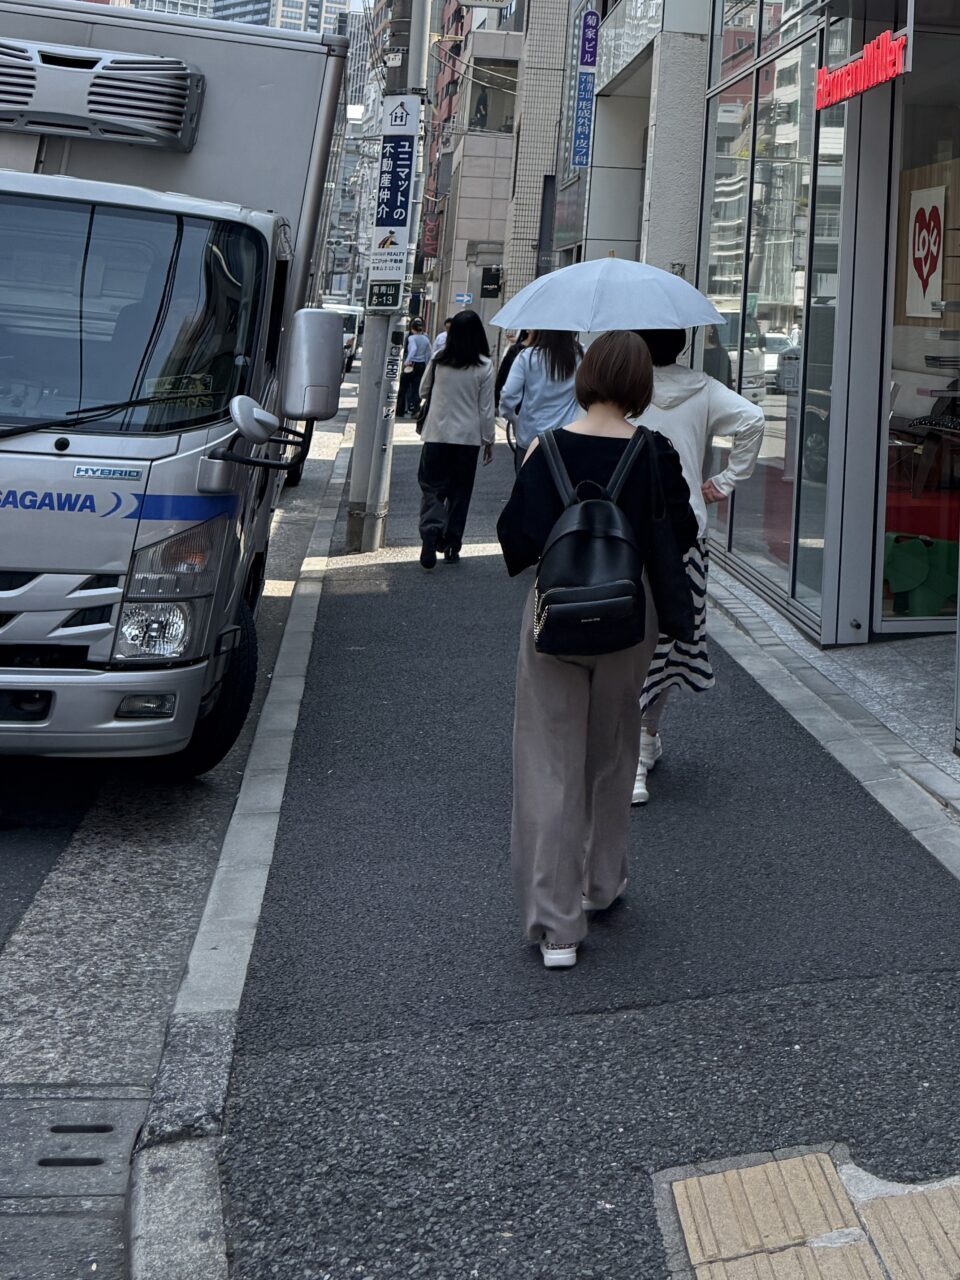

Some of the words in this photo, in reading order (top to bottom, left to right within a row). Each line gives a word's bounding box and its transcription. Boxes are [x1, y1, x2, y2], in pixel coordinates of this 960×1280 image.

[583, 15, 597, 63] 菊家ビル
[816, 29, 907, 110] HermanMiller
[377, 143, 395, 219] 不動産仲介
[393, 141, 412, 220] ユニマットの
[372, 285, 395, 294] 南青山
[372, 295, 393, 304] 5-13
[76, 466, 140, 479] HYBRID
[0, 489, 97, 513] AGAWA
